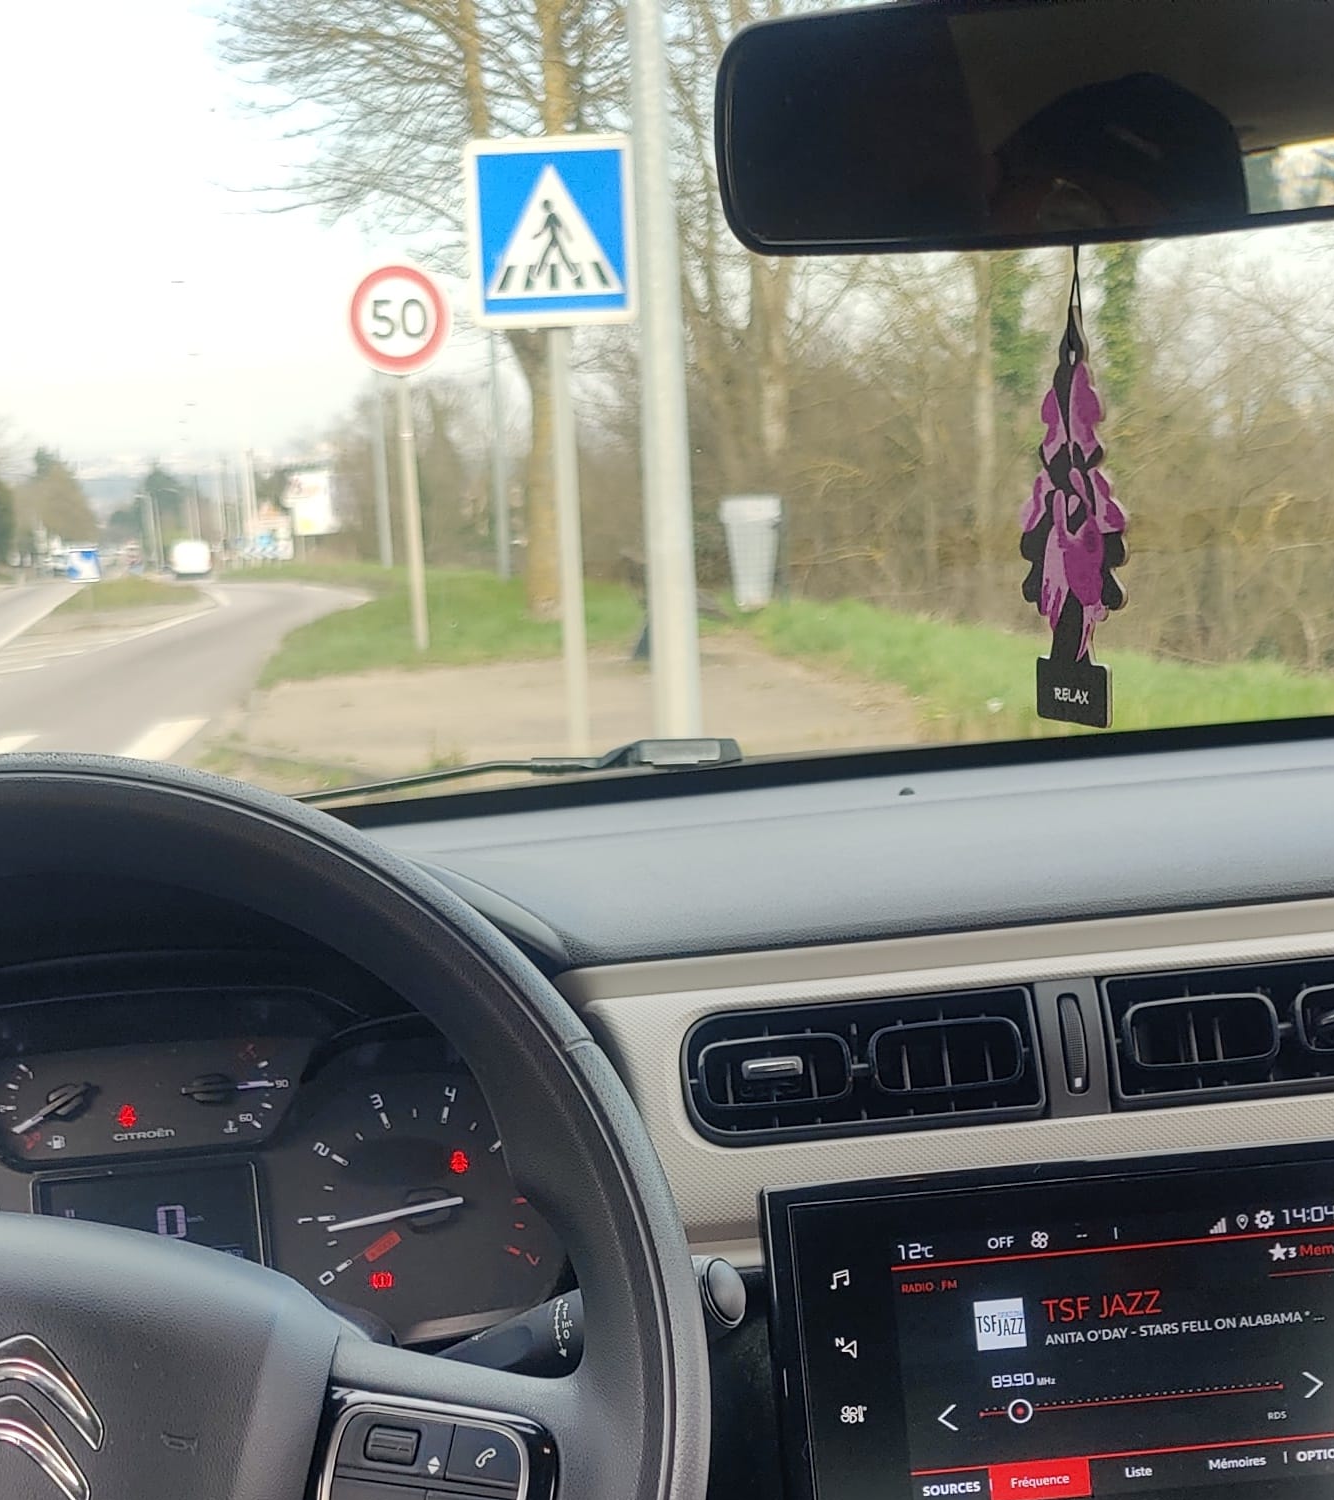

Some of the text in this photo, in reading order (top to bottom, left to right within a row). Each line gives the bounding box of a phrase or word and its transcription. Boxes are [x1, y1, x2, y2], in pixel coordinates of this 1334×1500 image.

[372, 298, 427, 339] 50
[1054, 687, 1089, 705] RELAX
[275, 1079, 289, 1089] 90
[370, 1093, 384, 1110] 3
[444, 1086, 457, 1102] 4
[239, 1113, 253, 1123] 60
[313, 1142, 330, 1157] 2
[156, 1205, 187, 1238] 0
[987, 1236, 1015, 1250] OFF
[1287, 1243, 1334, 1258] 3 Mem
[318, 1270, 335, 1286] 0
[901, 1280, 958, 1293] RADIO FM
[1041, 1289, 1163, 1323] TSF JAZZ
[976, 1314, 1025, 1336] TSF JAZZ
[1045, 1331, 1085, 1346] ANITA
[1087, 1327, 1128, 1342] O'DAY
[1139, 1323, 1179, 1337] STARS
[1181, 1319, 1212, 1333] FELL
[1214, 1316, 1237, 1330] ON
[1239, 1311, 1303, 1327] ALABAMA
[991, 1372, 1057, 1389] 89.90 MHz
[1267, 1410, 1288, 1421] RDS
[1208, 1456, 1267, 1470] Mémoires
[1124, 1466, 1153, 1478] Liste
[922, 1481, 981, 1497] SOURCES
[1010, 1474, 1071, 1490] Fréquence
